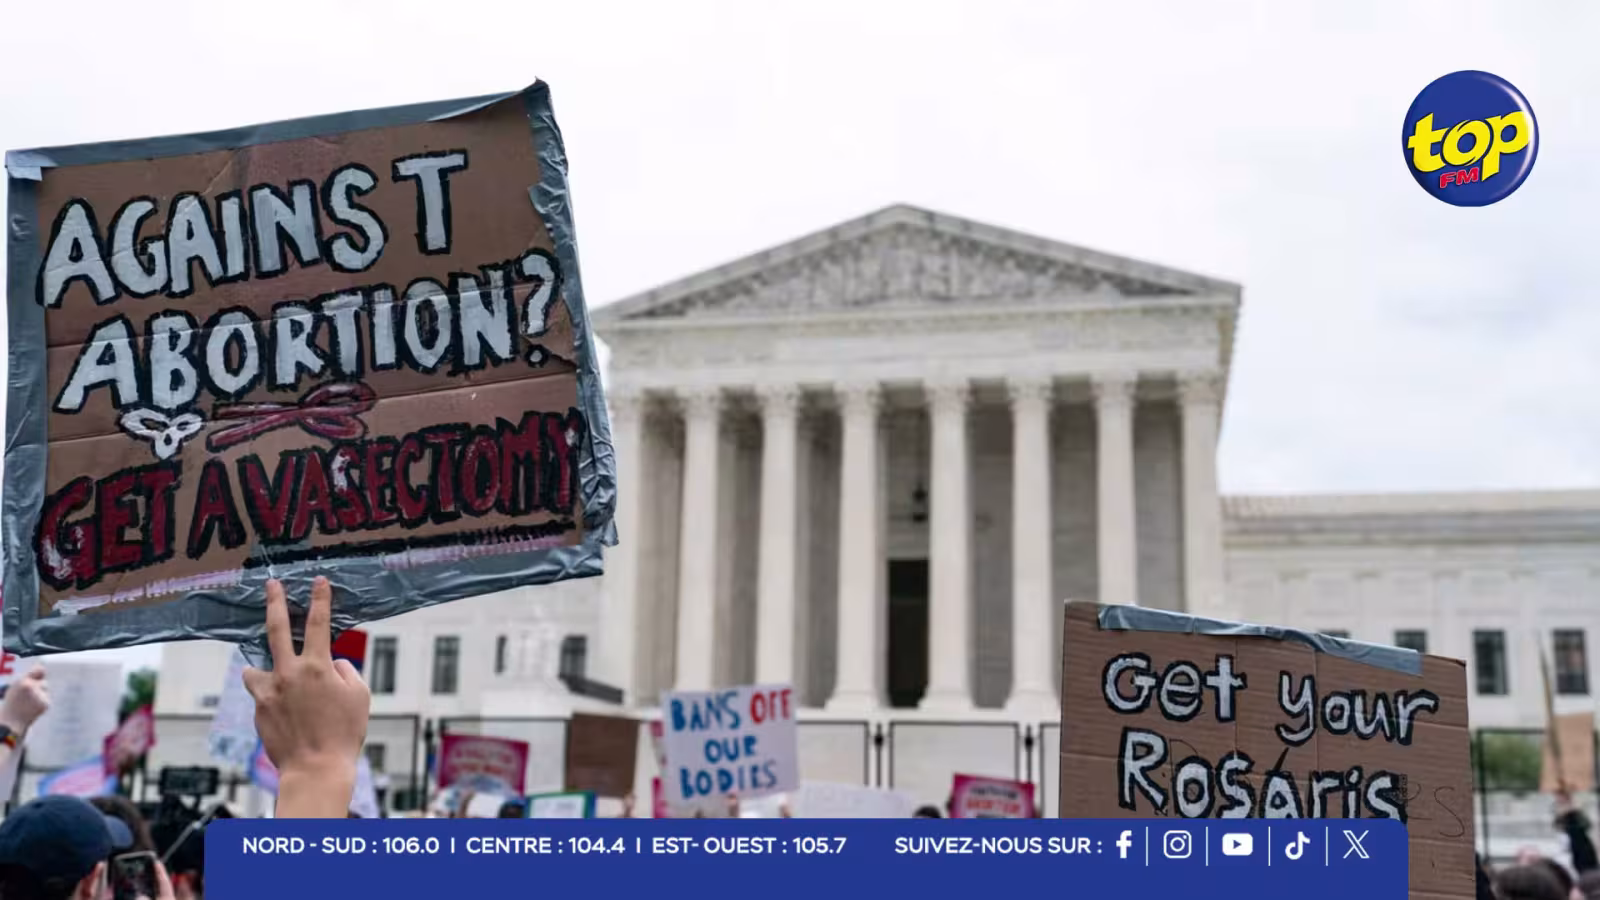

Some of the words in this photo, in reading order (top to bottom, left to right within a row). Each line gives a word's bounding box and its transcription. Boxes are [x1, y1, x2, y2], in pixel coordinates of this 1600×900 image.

[36, 149, 468, 309] AGAINST
[53, 249, 562, 415] ABORTION?
[34, 457, 182, 590] GET
[187, 456, 247, 560] A
[236, 409, 586, 546] VASECTOMY
[669, 689, 742, 733] BANS
[749, 688, 793, 726] OFF
[1102, 651, 1247, 723] Get
[1274, 669, 1439, 747] your
[679, 758, 778, 799] BODIES
[703, 734, 758, 764] OUR
